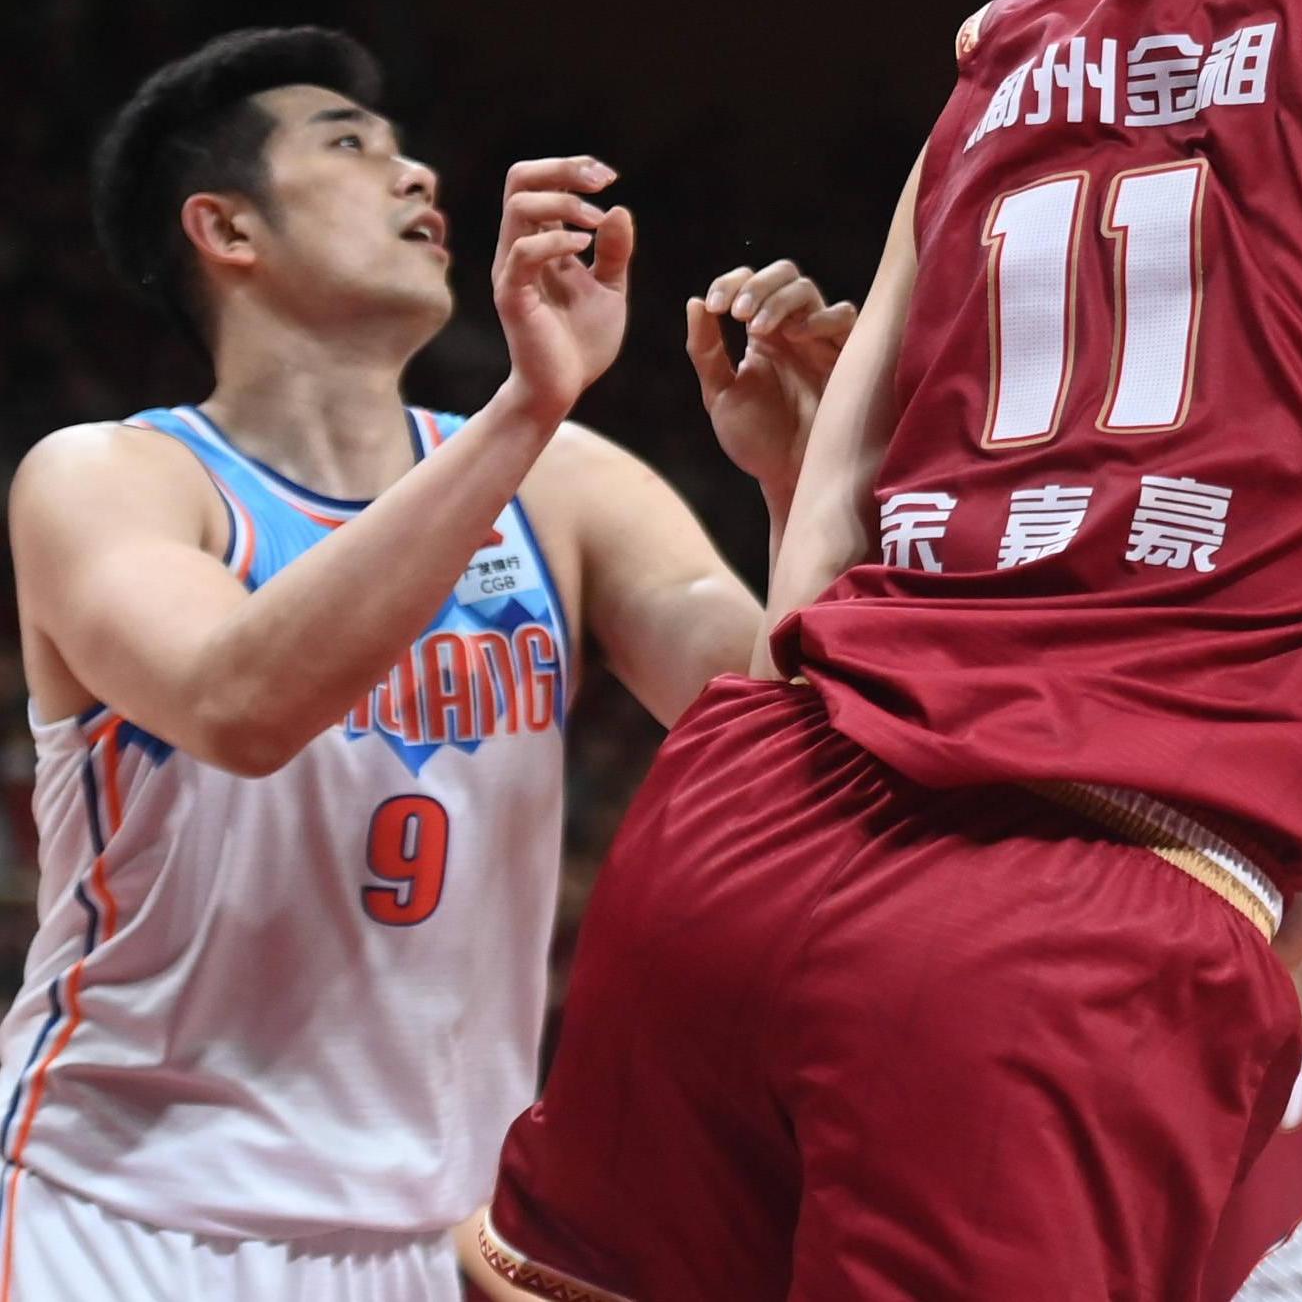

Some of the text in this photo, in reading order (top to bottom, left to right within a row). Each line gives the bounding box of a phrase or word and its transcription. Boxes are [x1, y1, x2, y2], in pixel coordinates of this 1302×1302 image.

[981, 157, 1209, 450] 11
[480, 575, 517, 595] CGB
[360, 794, 449, 927] 9
